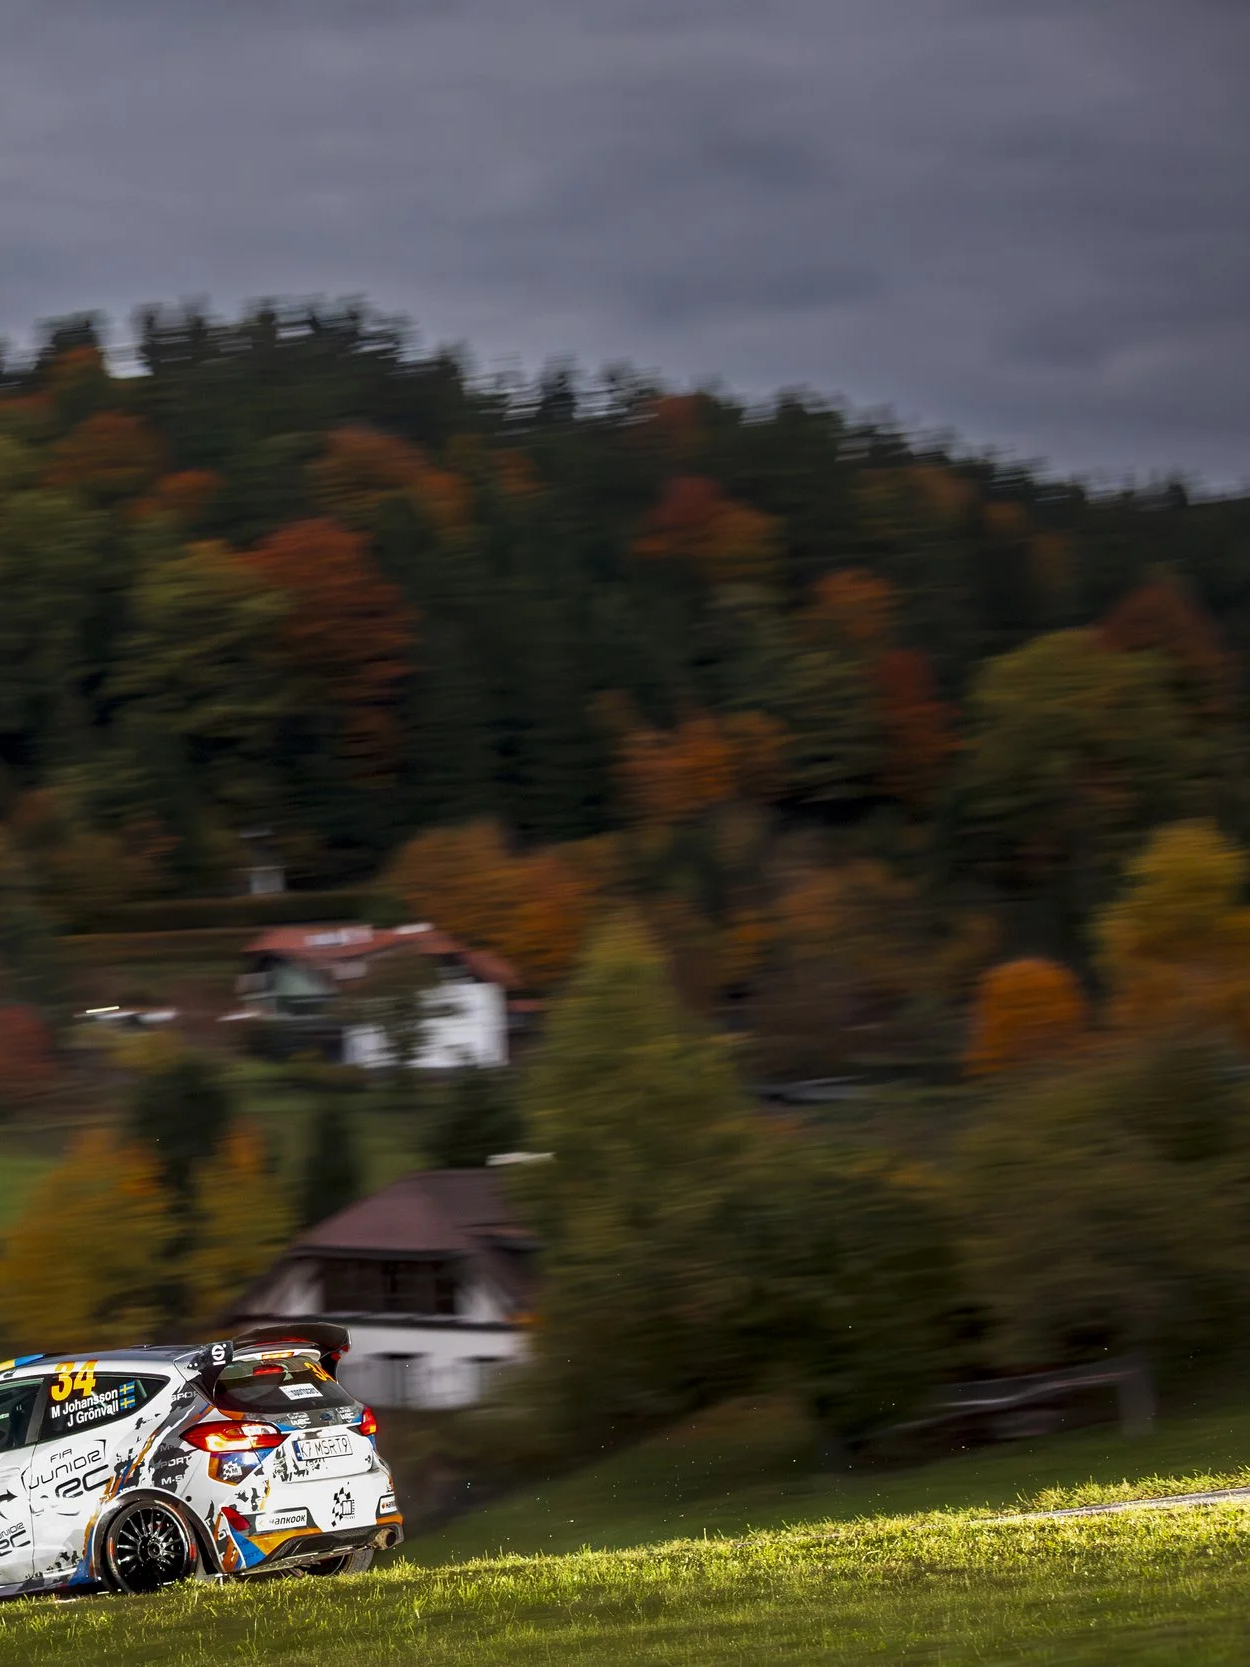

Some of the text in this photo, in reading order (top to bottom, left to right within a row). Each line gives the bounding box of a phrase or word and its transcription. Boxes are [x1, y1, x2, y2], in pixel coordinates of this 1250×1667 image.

[51, 1360, 98, 1401] 34
[51, 1389, 119, 1419] M Johansson
[67, 1399, 119, 1427] J Grönvall
[29, 1449, 102, 1490] JUNIOR
[50, 1448, 72, 1463] FIA
